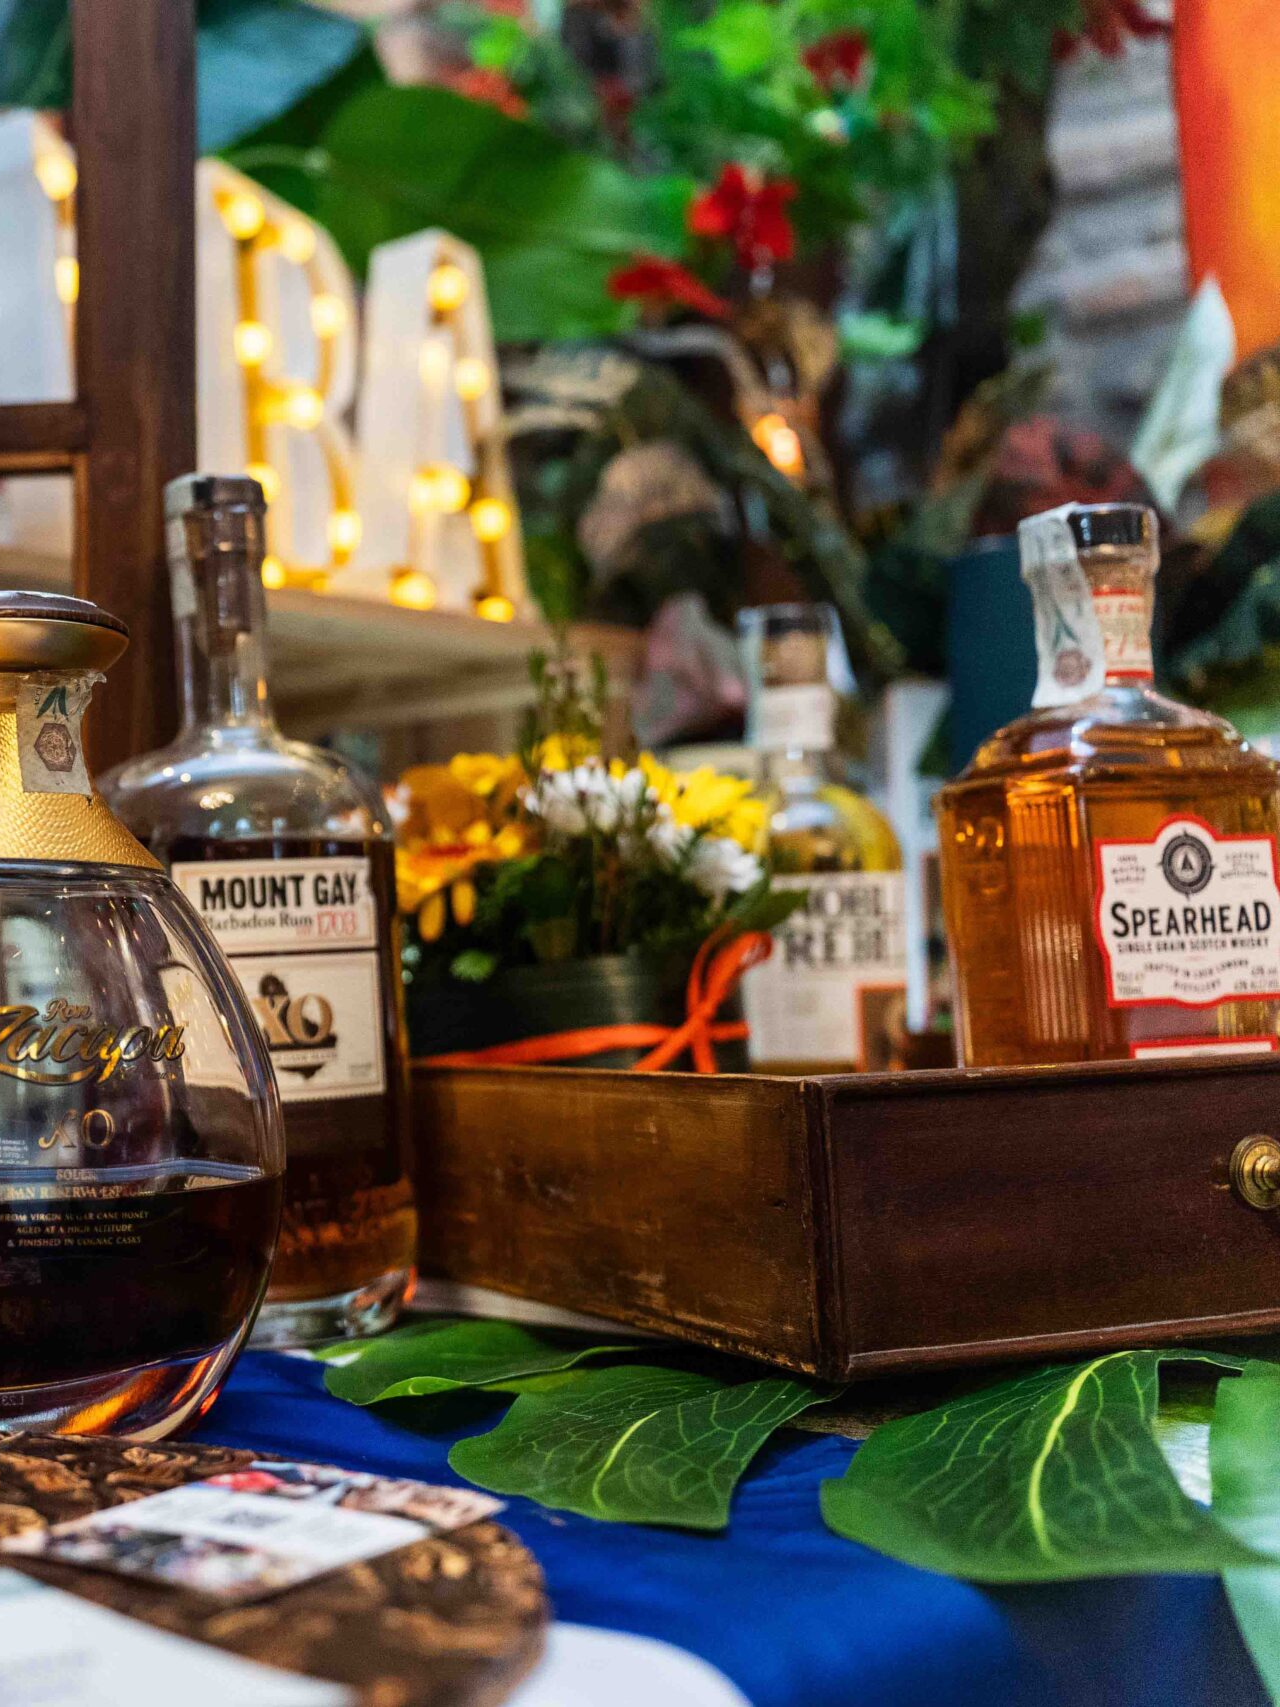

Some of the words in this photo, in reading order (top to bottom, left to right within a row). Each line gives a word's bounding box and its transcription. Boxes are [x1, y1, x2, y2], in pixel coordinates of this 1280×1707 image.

[200, 875, 304, 911] MOUNT
[314, 872, 357, 906] GAY
[279, 912, 314, 927] Rum
[317, 911, 357, 936] 1703
[1111, 901, 1271, 938] SPEARHEAD
[1118, 941, 1153, 953] SINGLE
[1156, 940, 1185, 952] GRAIN
[1189, 938, 1227, 951] SCOTCH
[1231, 936, 1269, 949] WHISKY
[42, 998, 93, 1022] Ron
[38, 1109, 116, 1150] XO
[0, 1213, 27, 1223] FROM
[30, 1212, 62, 1222] VIRGIN
[97, 1211, 119, 1220] CANE
[121, 1209, 150, 1220] HONEY
[16, 1226, 41, 1235] AGED
[19, 1238, 61, 1247] FINISHED
[64, 1238, 74, 1247] IN
[77, 1237, 114, 1247] COGNAC
[116, 1236, 142, 1246] CASKS
